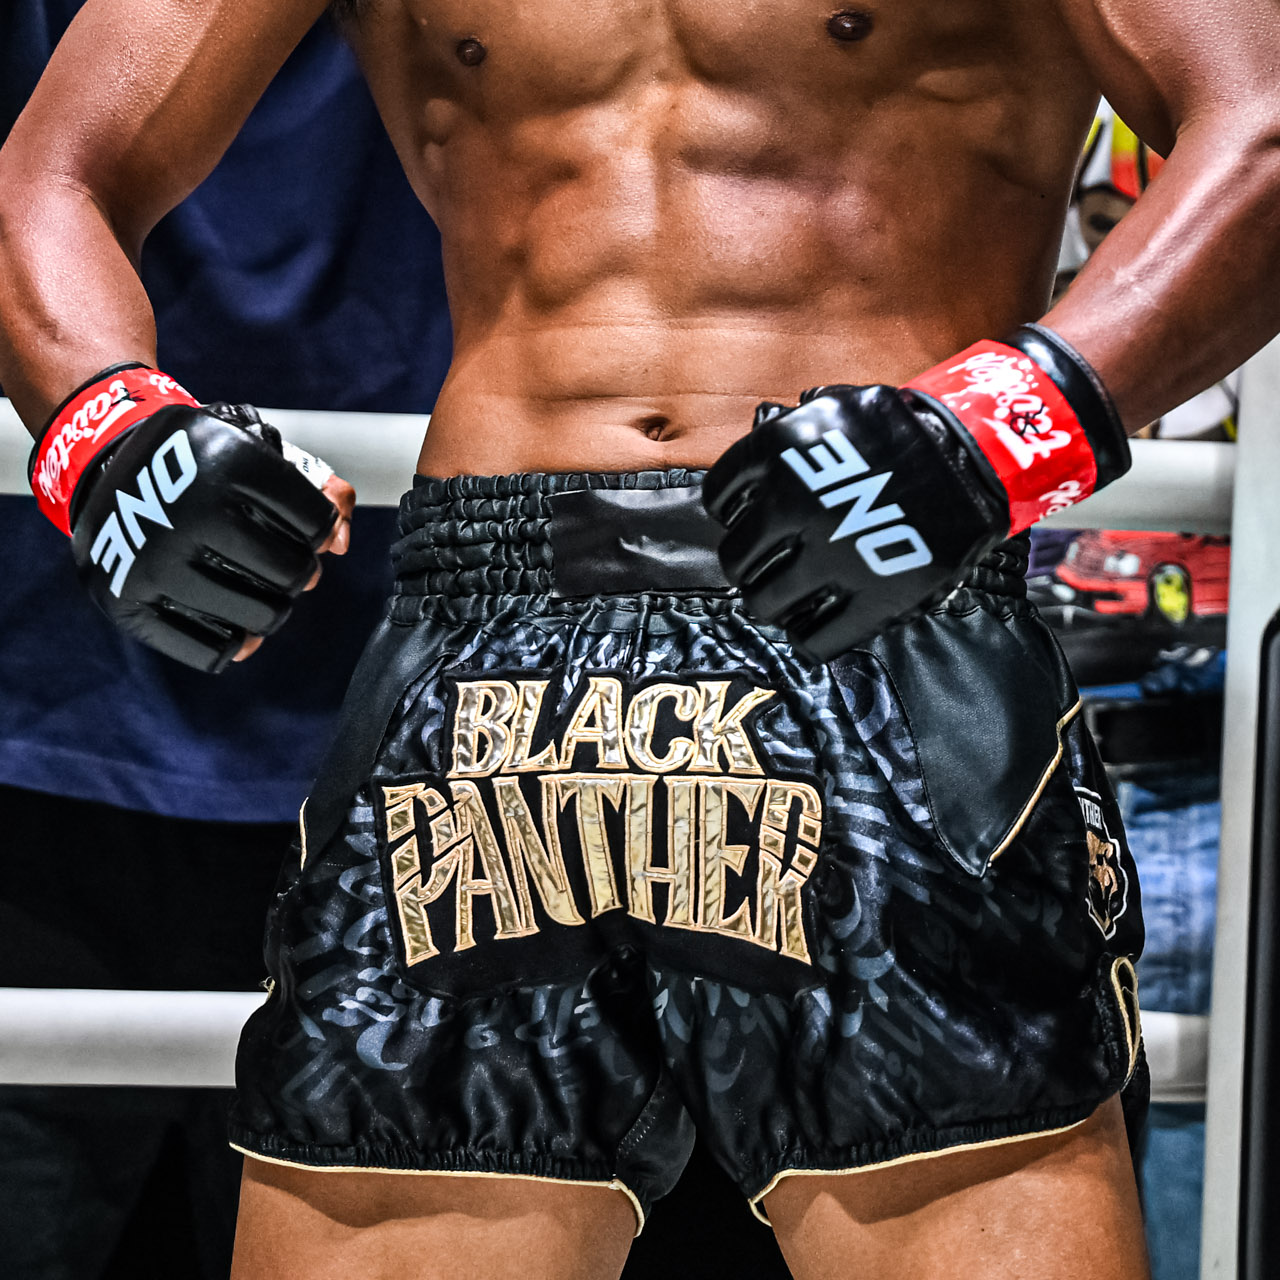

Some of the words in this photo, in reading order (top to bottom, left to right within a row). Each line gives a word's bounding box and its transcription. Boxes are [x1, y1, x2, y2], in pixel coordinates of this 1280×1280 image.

[90, 429, 198, 598] ONE
[780, 428, 933, 577] ONE
[447, 677, 777, 779] BLACK
[382, 771, 823, 968] PANTHER
